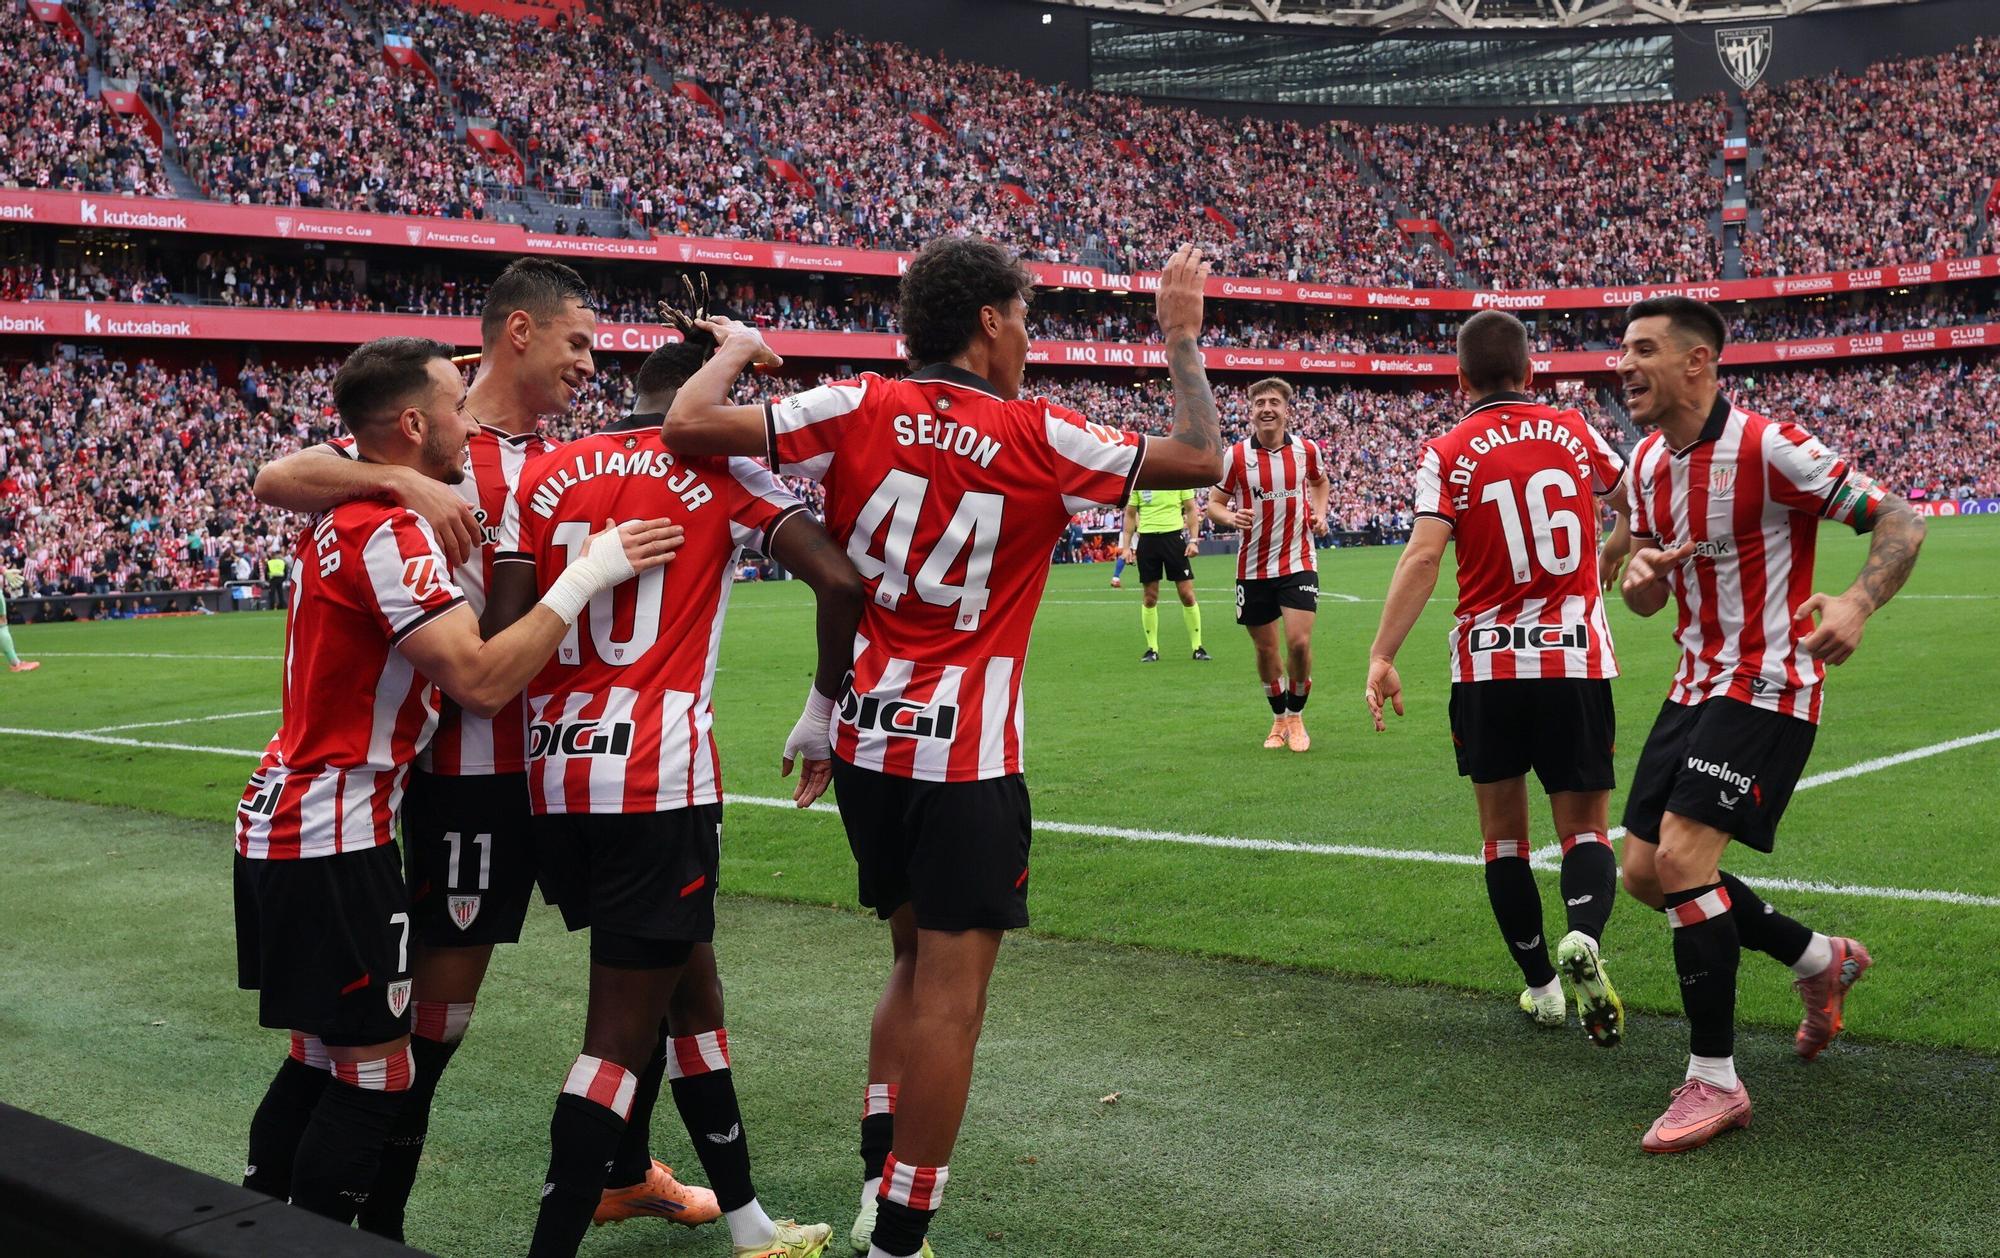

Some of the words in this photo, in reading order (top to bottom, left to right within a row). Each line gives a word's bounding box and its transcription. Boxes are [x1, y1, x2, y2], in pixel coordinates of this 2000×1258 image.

[103, 209, 187, 229] kutxabank
[298, 222, 344, 235] ATHLETIC
[346, 225, 373, 237] CLUB
[427, 231, 469, 243] ATHLETIC
[471, 234, 496, 245] CLUB
[526, 238, 658, 255] WWW.ATHLETIC-CLUB.EUS
[695, 249, 732, 260] ATHLETIC
[734, 251, 754, 262] CLUB
[789, 255, 824, 266] ATHLETIC
[825, 257, 843, 267] CLUB
[1897, 265, 1931, 278] CLUB
[1947, 259, 1981, 272] CLUB
[1062, 270, 1094, 287] IMQ
[1101, 273, 1132, 290] IMQ
[1848, 269, 1882, 282] CLUB
[1233, 286, 1262, 295] LEXUS
[1306, 291, 1333, 300] LEXUS
[1376, 292, 1430, 306] @athletic_eus
[1603, 291, 1643, 304] CLUB
[1489, 293, 1546, 308] Petronor
[107, 318, 191, 336] kutxabank
[1950, 328, 1985, 340] CLUB
[1849, 336, 1884, 348] CLUB
[1902, 332, 1936, 344] CLUB
[1066, 346, 1097, 363] IMQ
[1104, 348, 1135, 365] IMQ
[1235, 357, 1264, 365] LEXUS
[1308, 360, 1336, 368] LEXUS
[1380, 359, 1433, 373] @athletic_eus
[893, 414, 1002, 469] SELTON
[1470, 420, 1592, 479] GALARRETA
[530, 450, 675, 520] WILLIAMS
[667, 468, 714, 512] JR
[1481, 468, 1582, 585] 16
[846, 468, 1005, 632] 44
[551, 519, 666, 666] 10
[1469, 624, 1588, 654] DIGI
[837, 671, 956, 741] DIGI
[528, 721, 633, 757] DIGI
[1686, 756, 1755, 794] vueling
[443, 831, 492, 890] 11
[389, 911, 410, 973] 7
